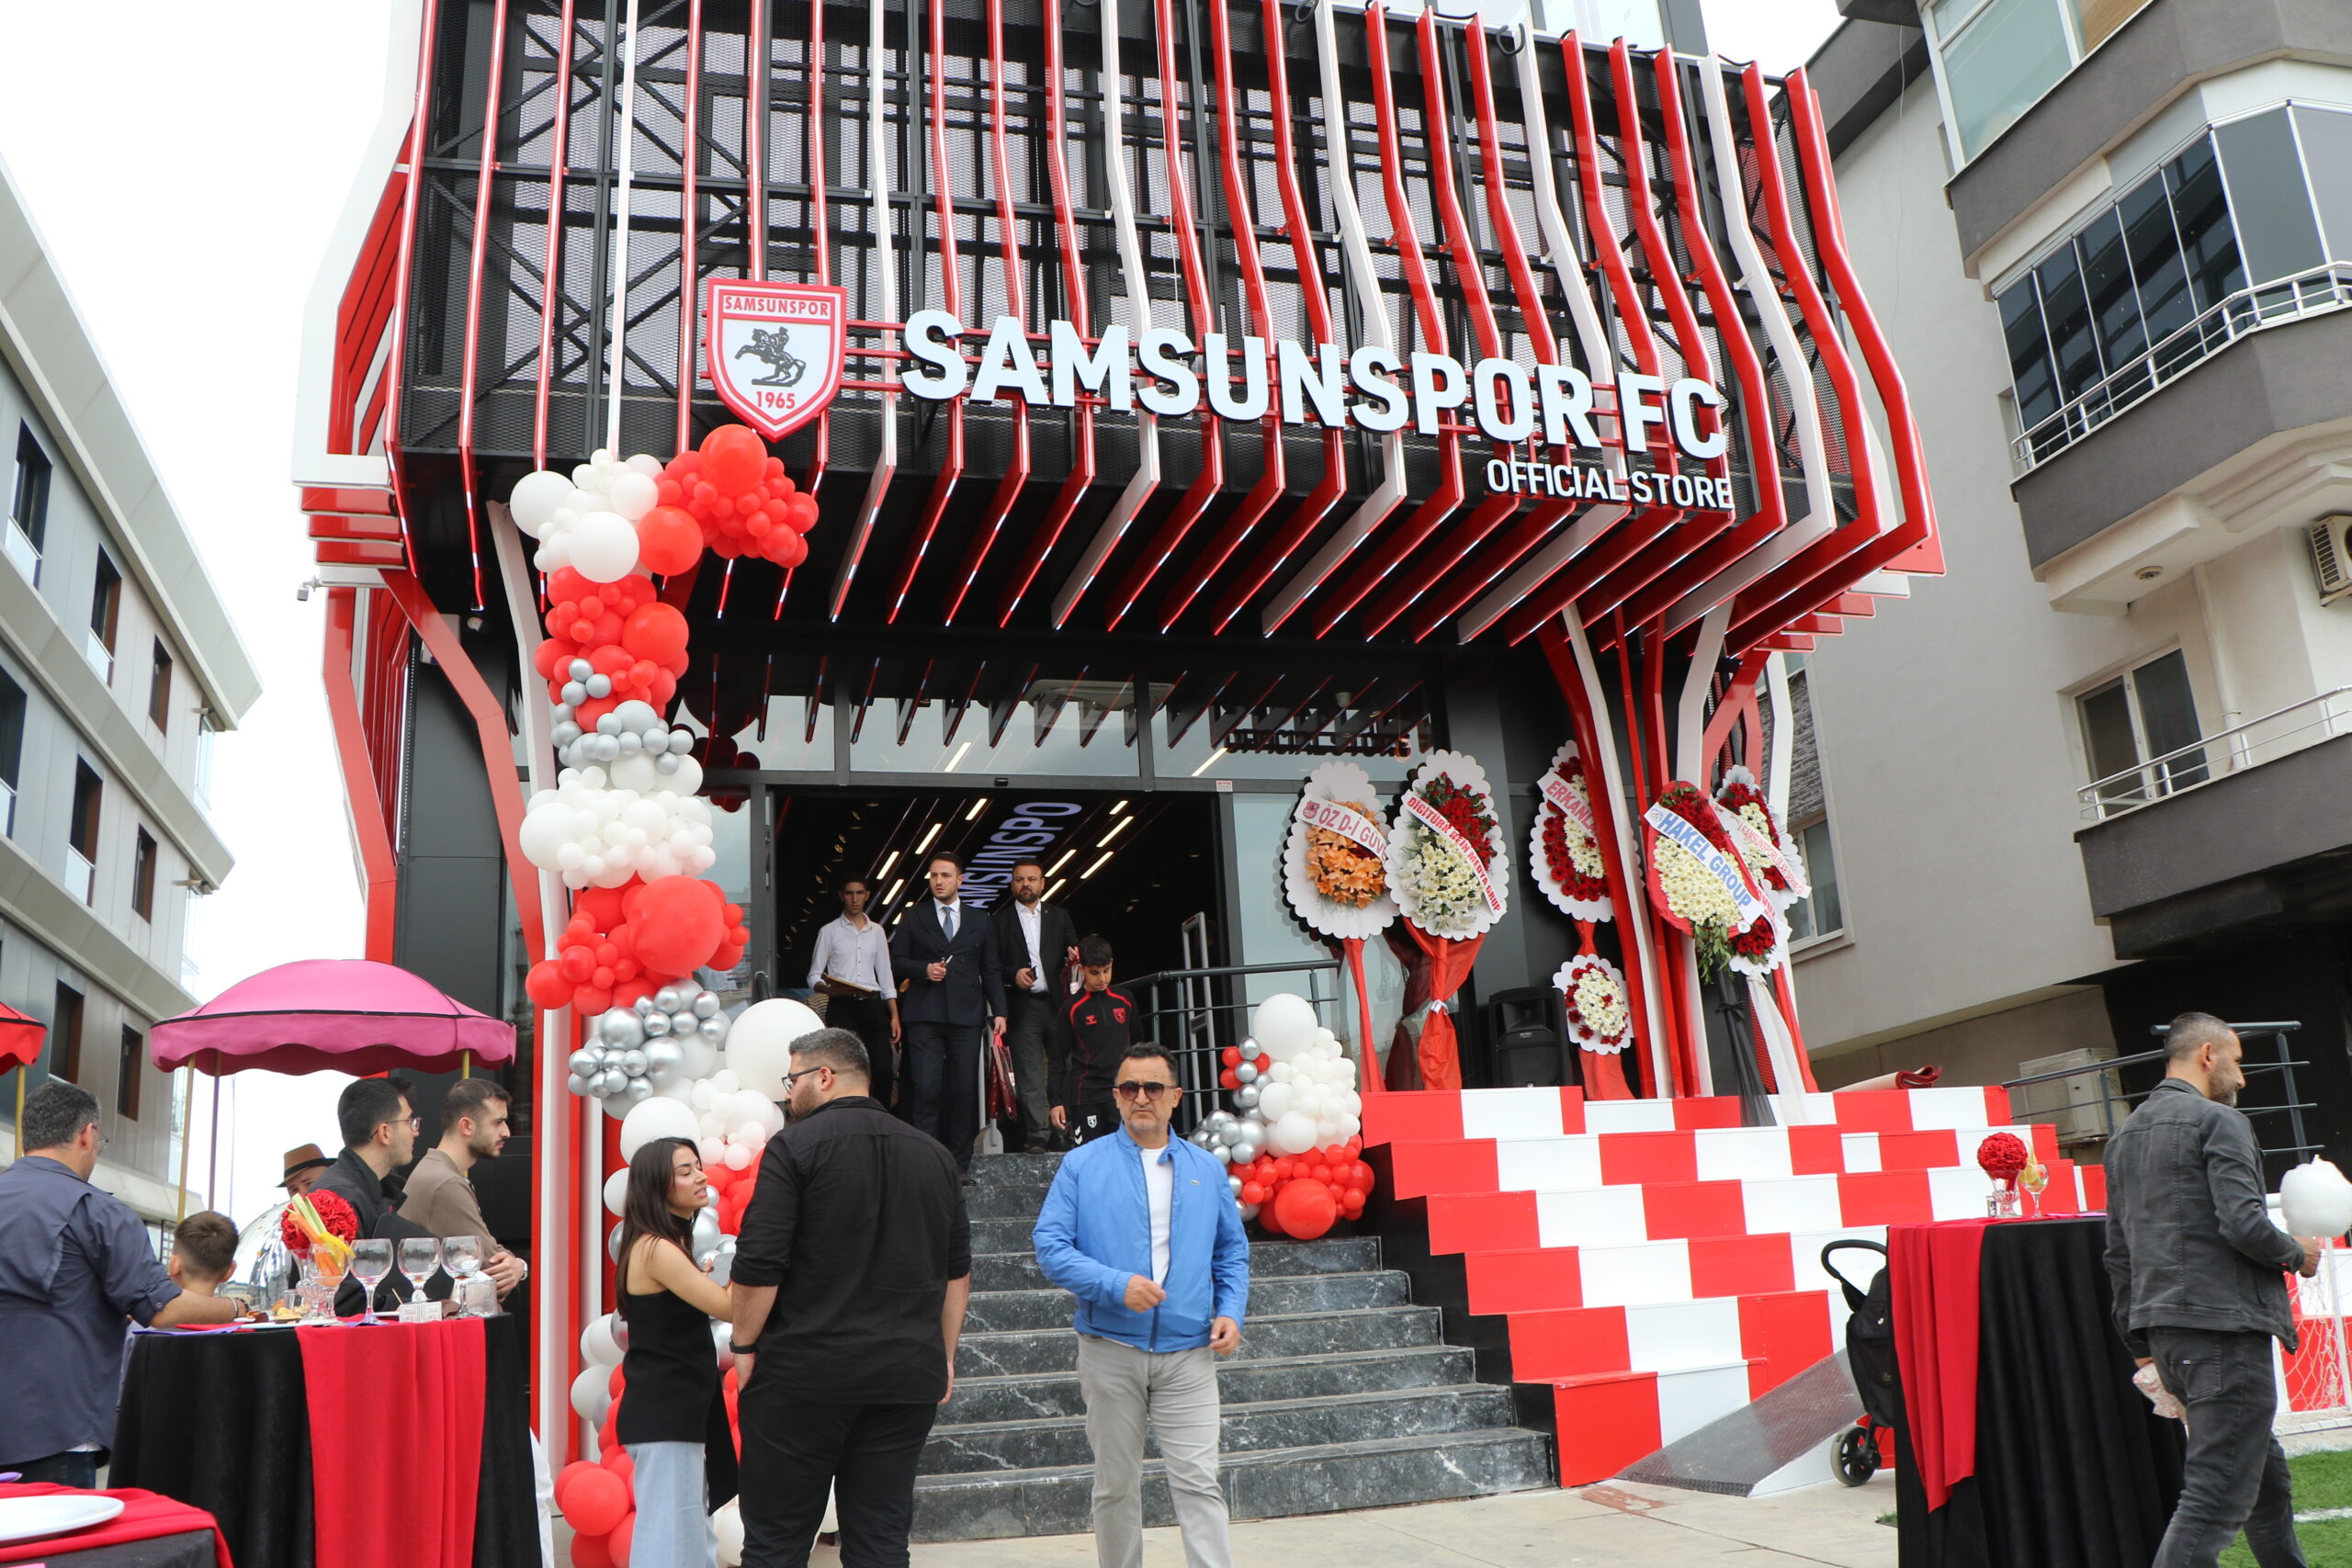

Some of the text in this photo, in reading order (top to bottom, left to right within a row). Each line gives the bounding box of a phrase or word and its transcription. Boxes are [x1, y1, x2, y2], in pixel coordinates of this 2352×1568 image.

[724, 296, 829, 316] SAMSUNSPOR
[901, 309, 1727, 460] SAMSUNSPOR FC
[756, 390, 796, 409] 1965
[1487, 459, 1735, 509] OFFICIAL STORE
[1318, 804, 1340, 828] ÖZ
[1657, 812, 1753, 908] HAKEL GROUP
[1486, 885, 1502, 912] GRUP
